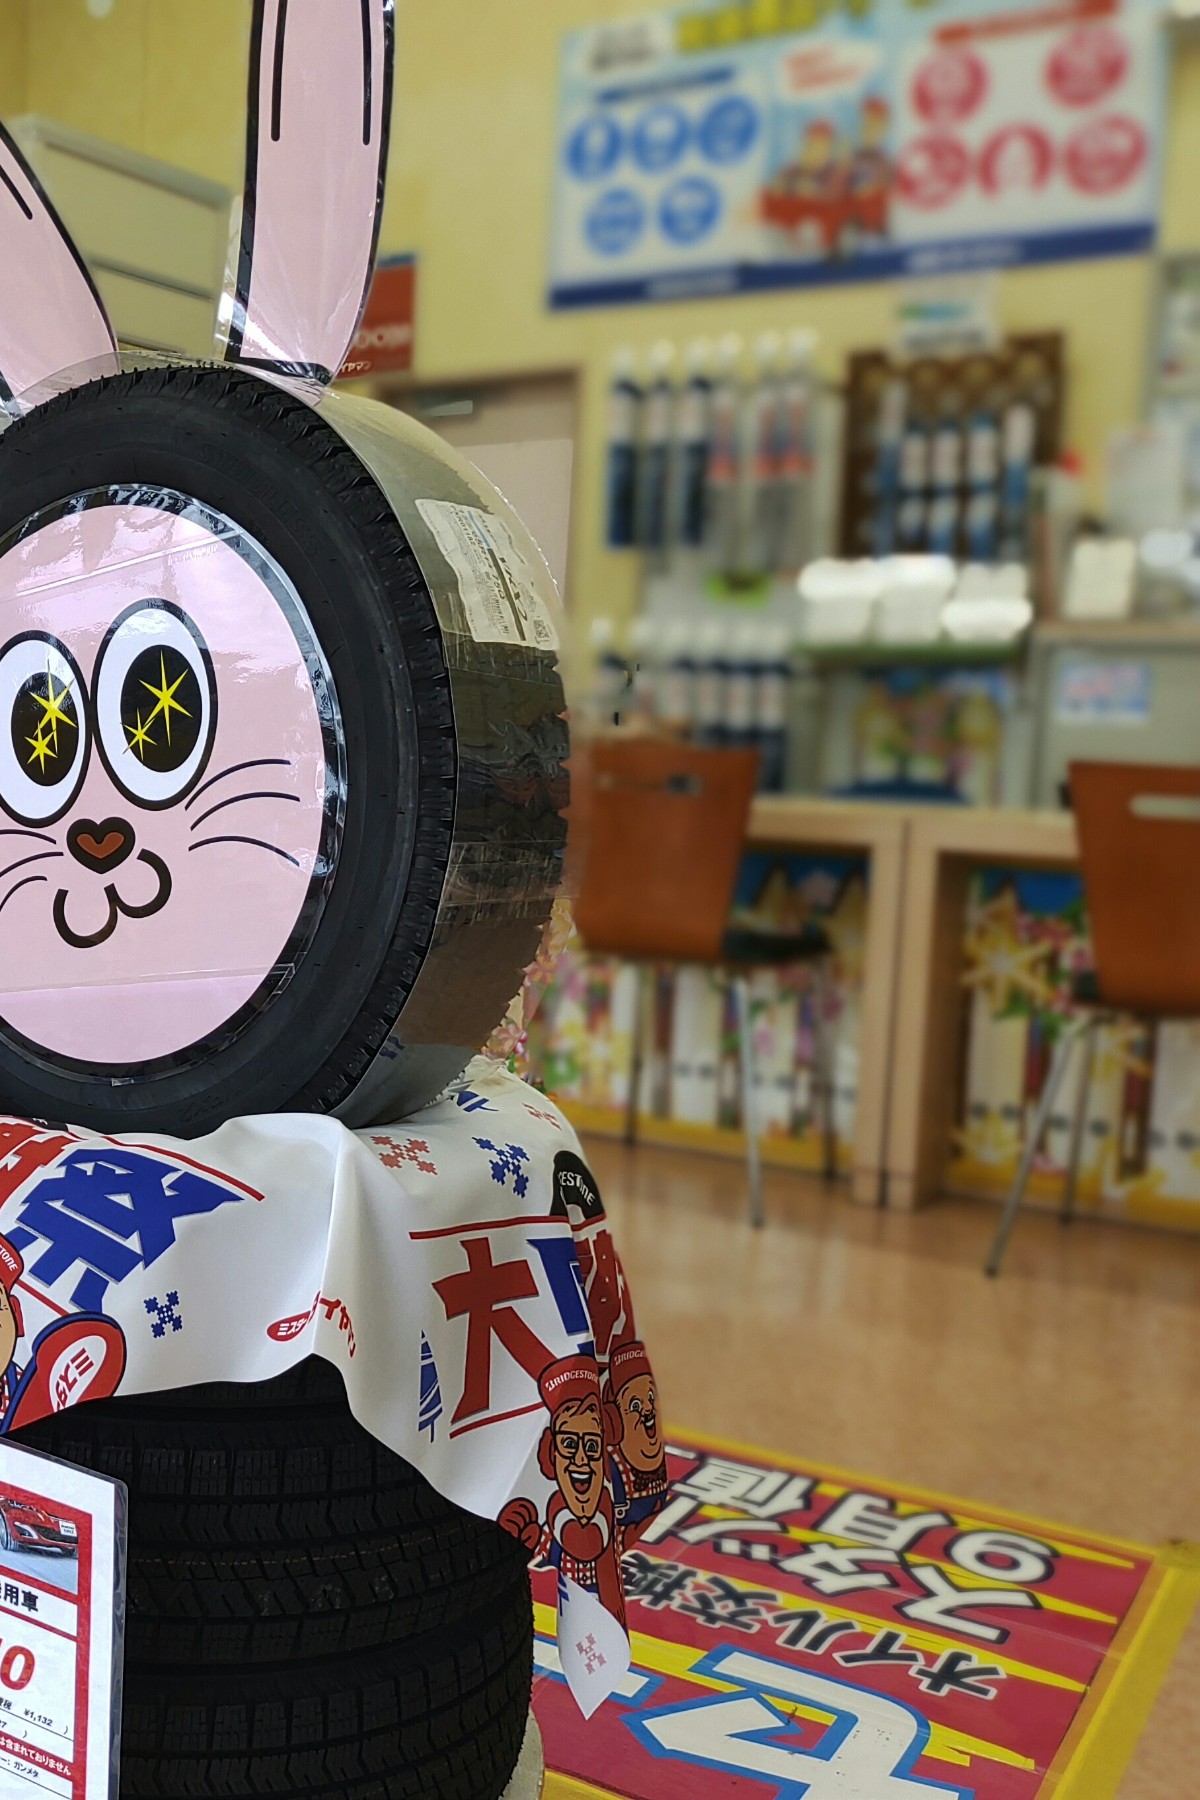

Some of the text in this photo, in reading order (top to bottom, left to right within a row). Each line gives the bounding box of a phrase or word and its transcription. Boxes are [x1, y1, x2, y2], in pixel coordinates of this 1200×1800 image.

[277, 1318, 308, 1336] ミスタ
[56, 1347, 94, 1410] ミスタ
[666, 1448, 1058, 1584] 9月値
[24, 1708, 53, 1727] ¥1,132
